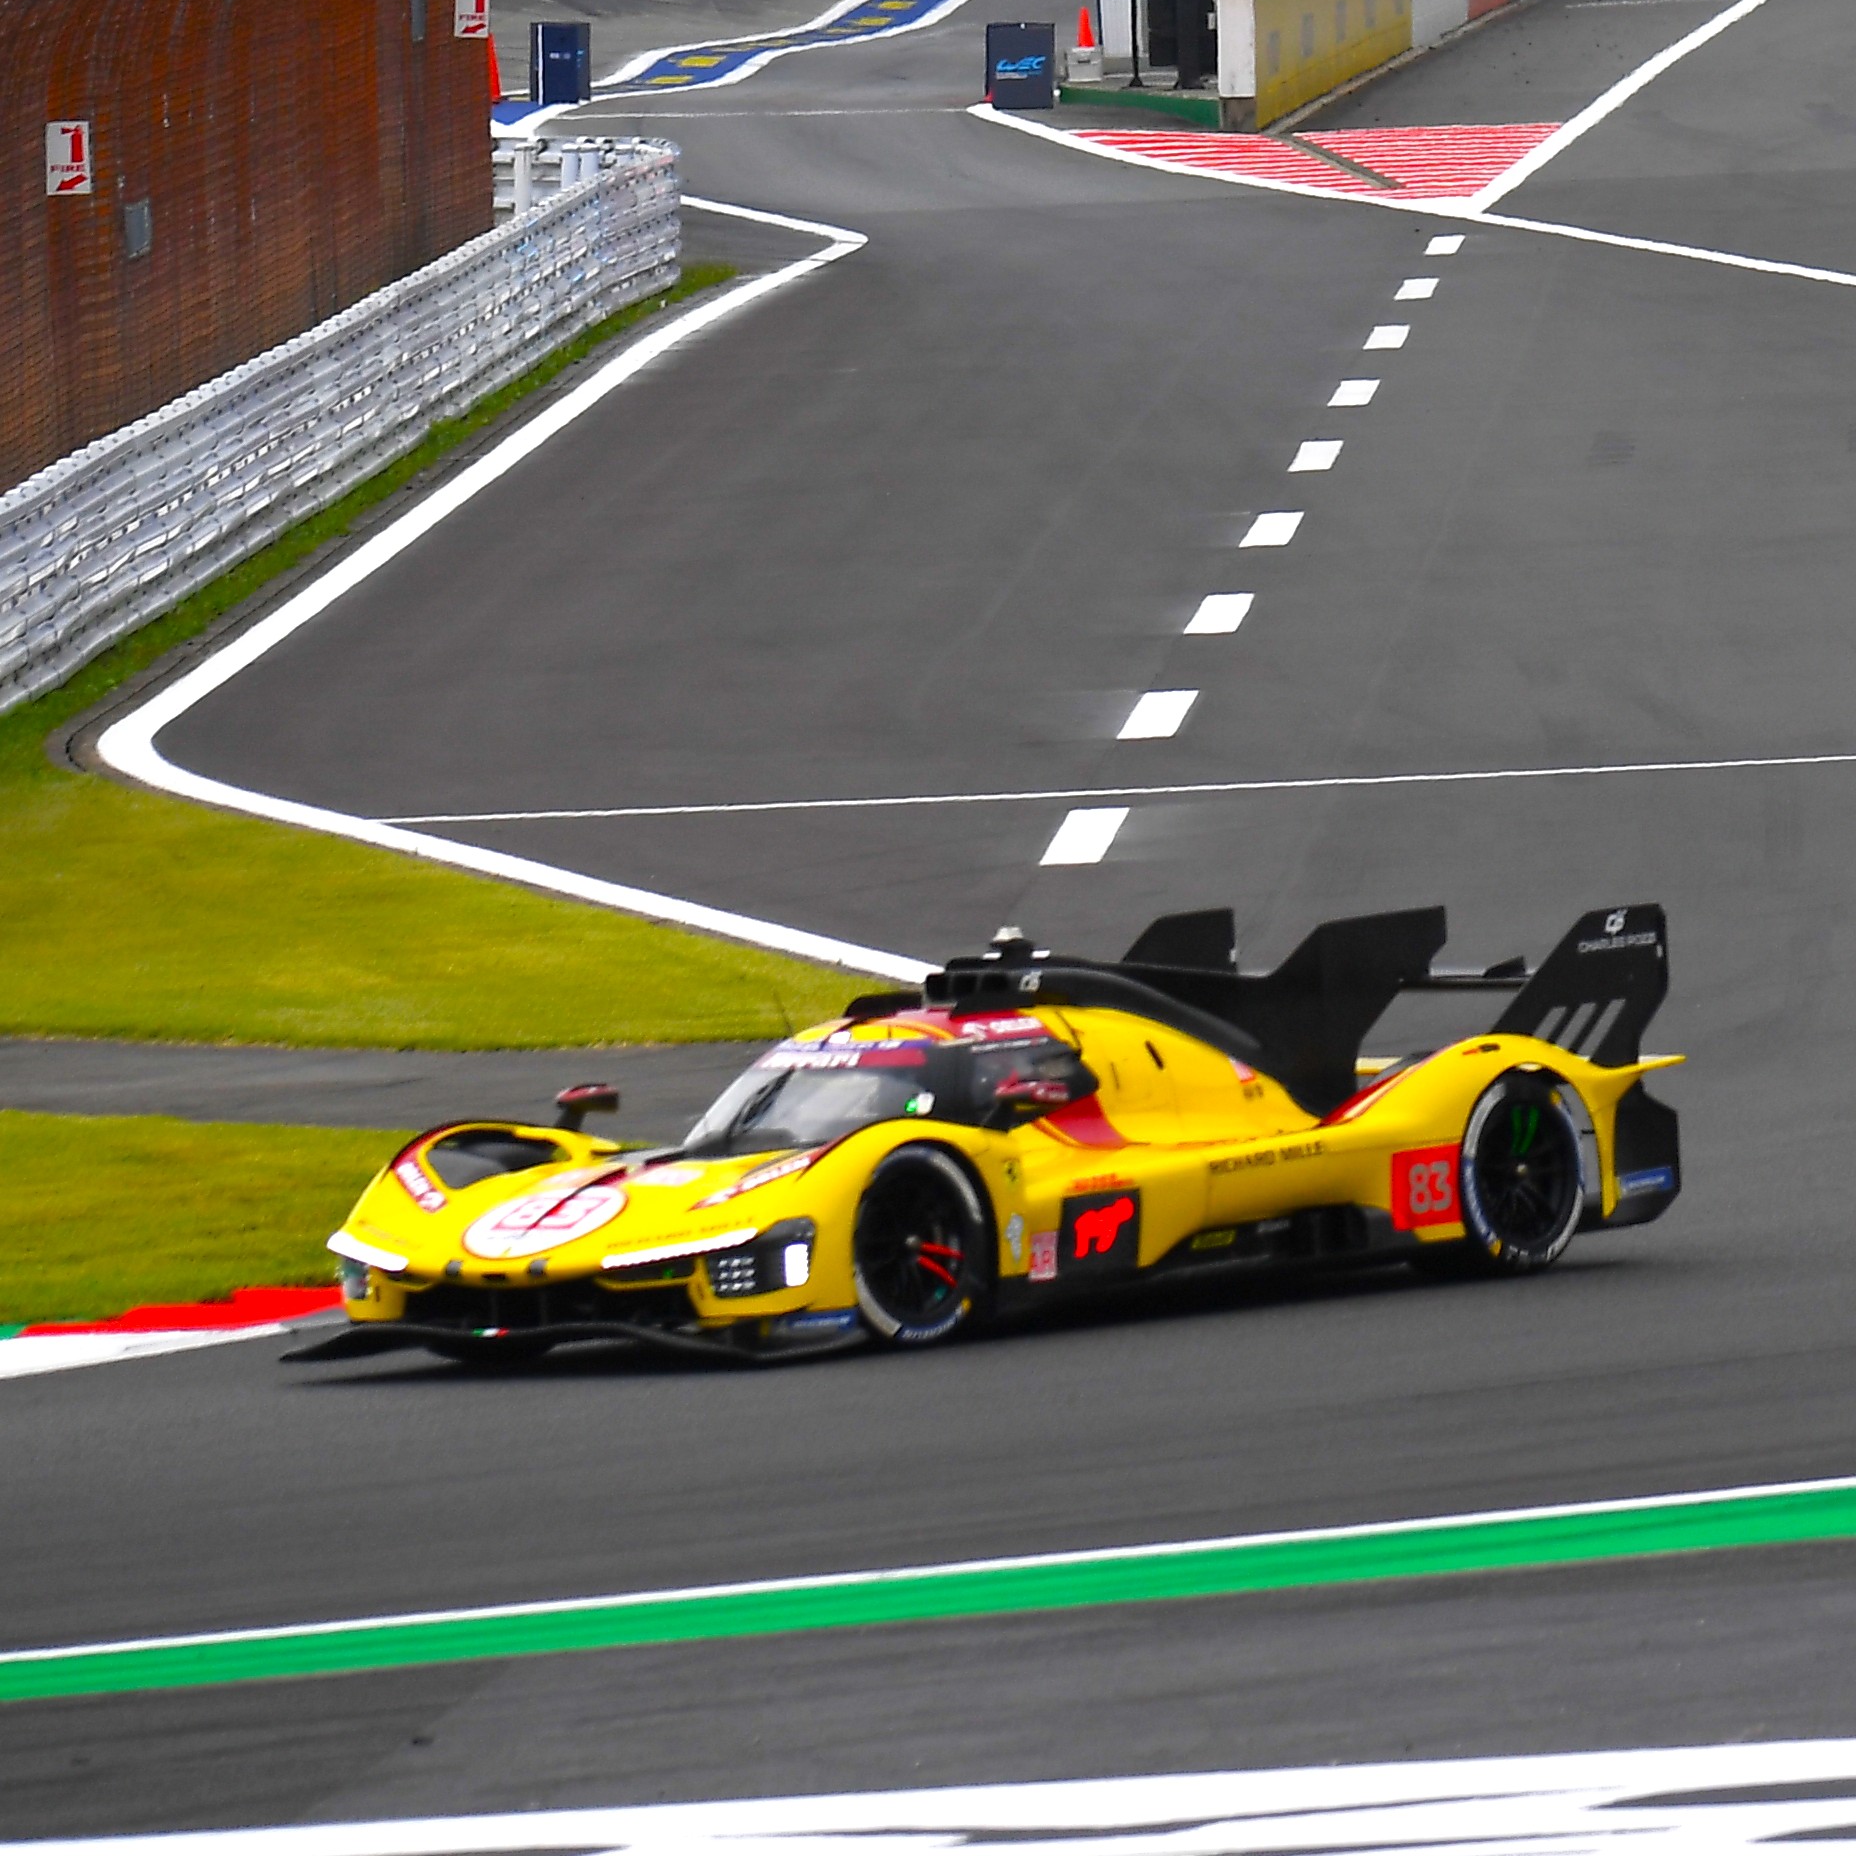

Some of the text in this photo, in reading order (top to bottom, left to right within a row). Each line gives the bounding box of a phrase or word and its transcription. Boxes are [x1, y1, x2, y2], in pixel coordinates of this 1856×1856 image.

[50, 163, 86, 172] FIRE
[1280, 1144, 1324, 1162] MILLE
[1408, 1162, 1452, 1214] 83
